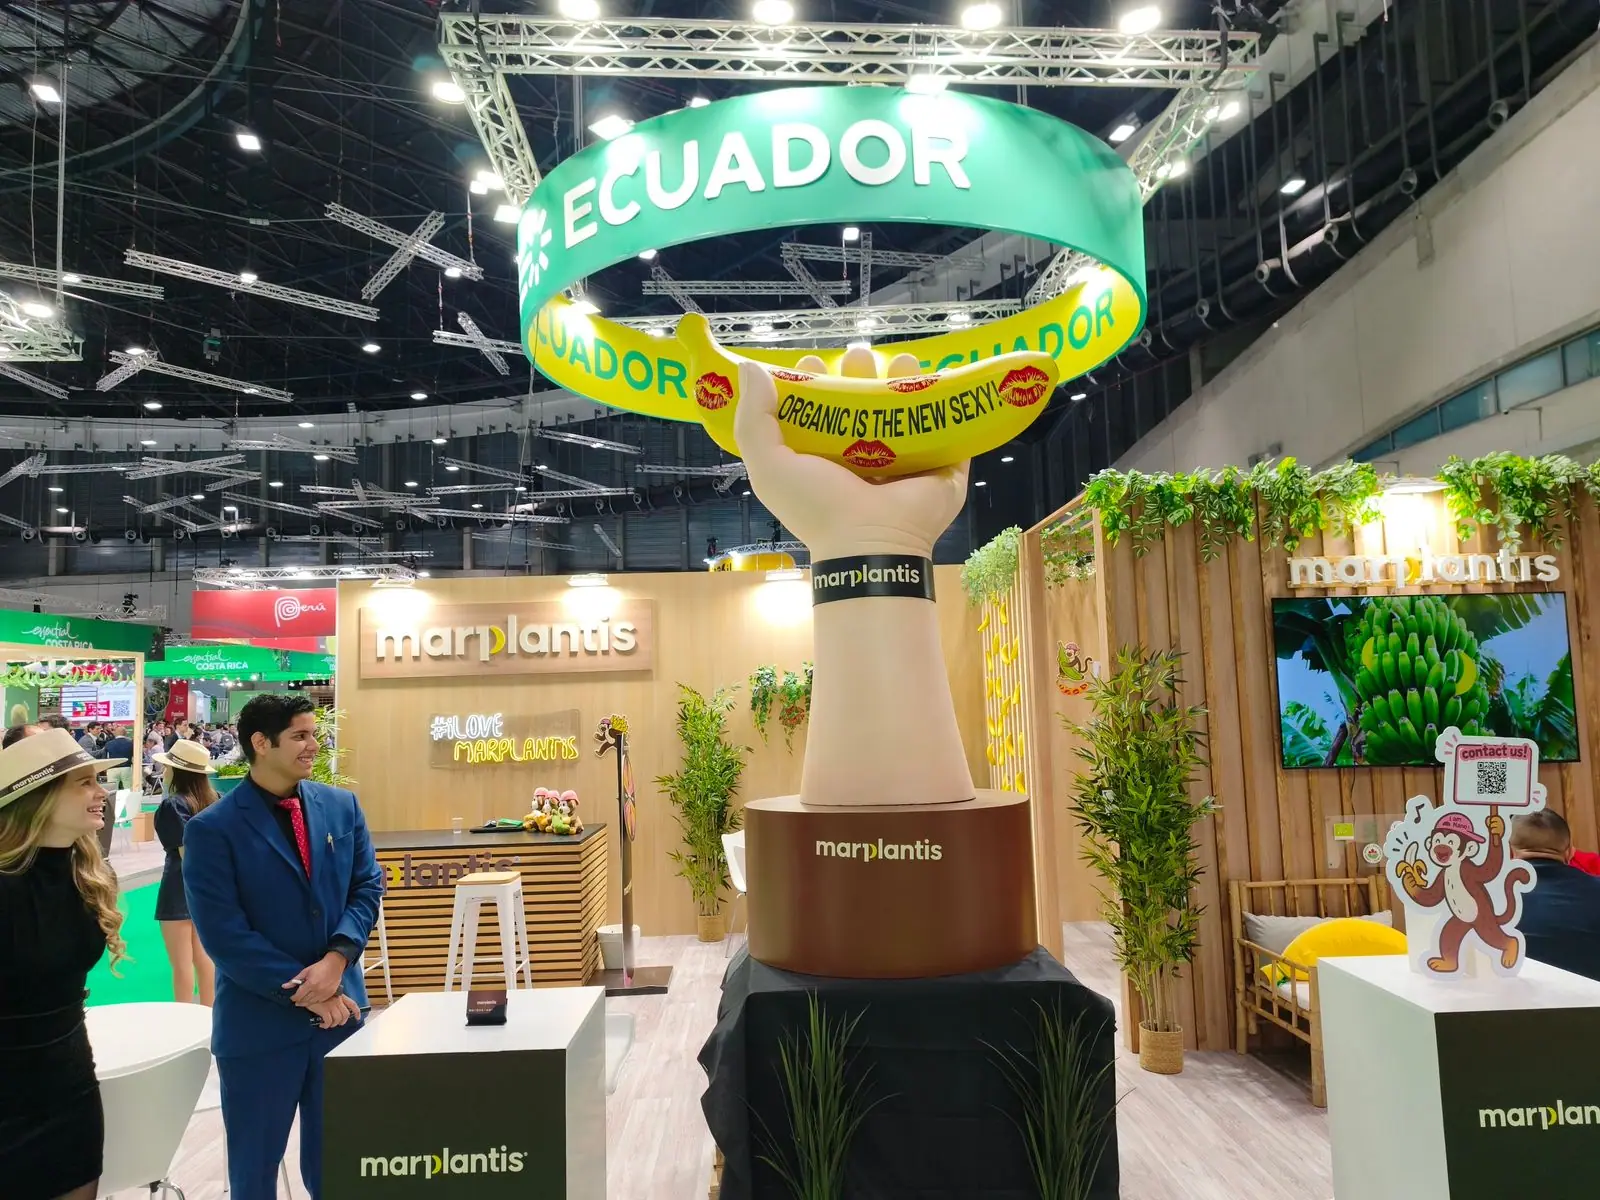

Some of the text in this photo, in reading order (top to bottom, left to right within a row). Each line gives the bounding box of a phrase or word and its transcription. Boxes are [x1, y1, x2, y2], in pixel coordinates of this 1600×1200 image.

[563, 119, 971, 249] ECUADOR
[778, 380, 1003, 438] ORGANIC IS THE NEW SEXY!
[814, 563, 920, 590] marplantis
[1290, 546, 1560, 589] marplantis
[45, 639, 73, 648] COSTA
[376, 614, 638, 662] marplantis
[195, 660, 249, 671] COSTA RICA
[1462, 744, 1528, 759] contact us!
[815, 838, 943, 863] marplantis
[360, 1145, 524, 1180] marplantis
